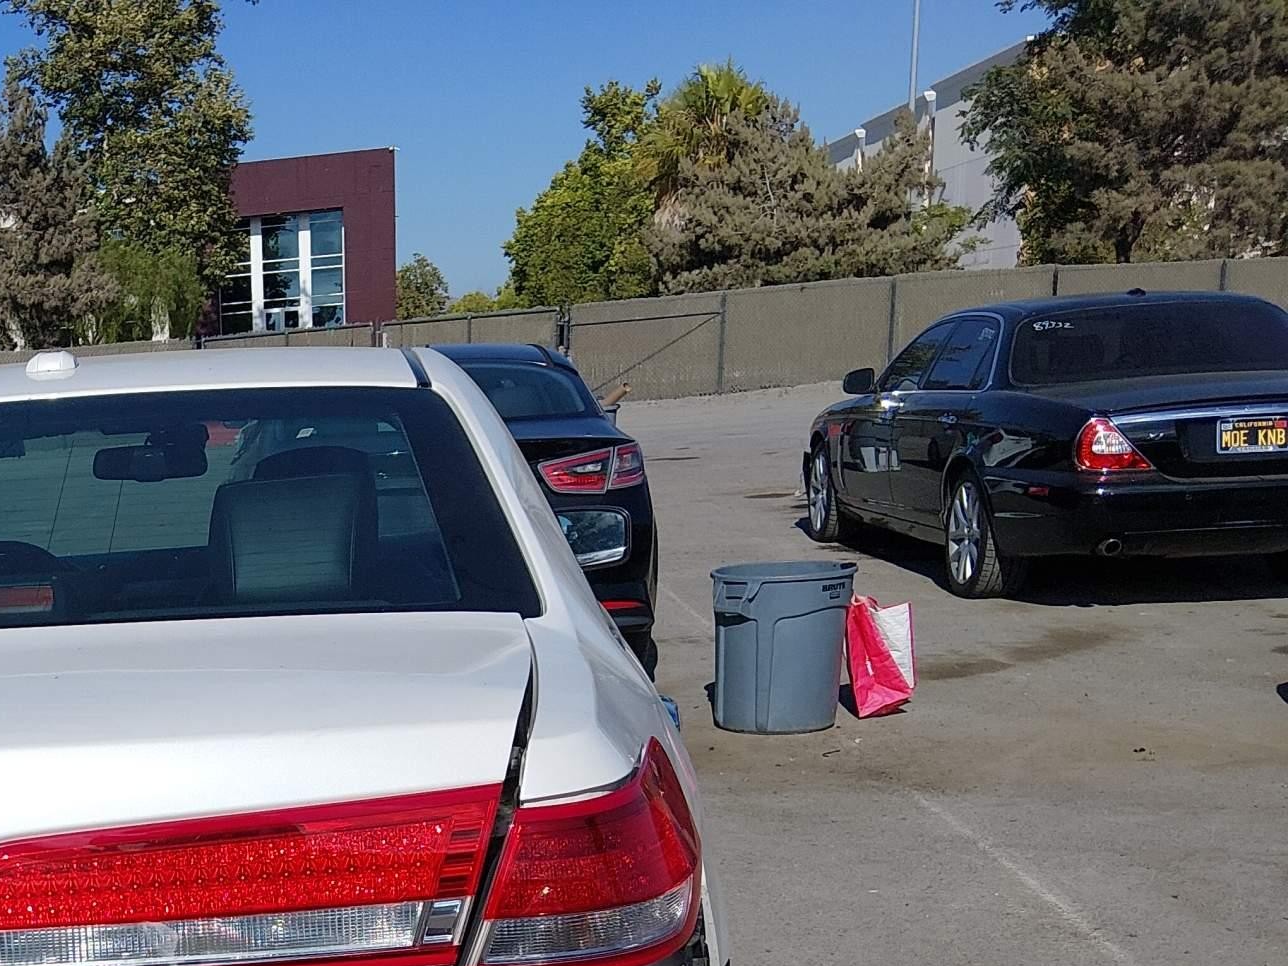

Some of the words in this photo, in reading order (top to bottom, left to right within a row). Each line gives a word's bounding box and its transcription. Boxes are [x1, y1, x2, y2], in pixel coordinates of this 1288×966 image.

[1234, 420, 1274, 428] CALIFORNIA
[1221, 429, 1249, 448] MOE
[1257, 428, 1286, 446] KNB
[821, 581, 846, 593] BRUTE
